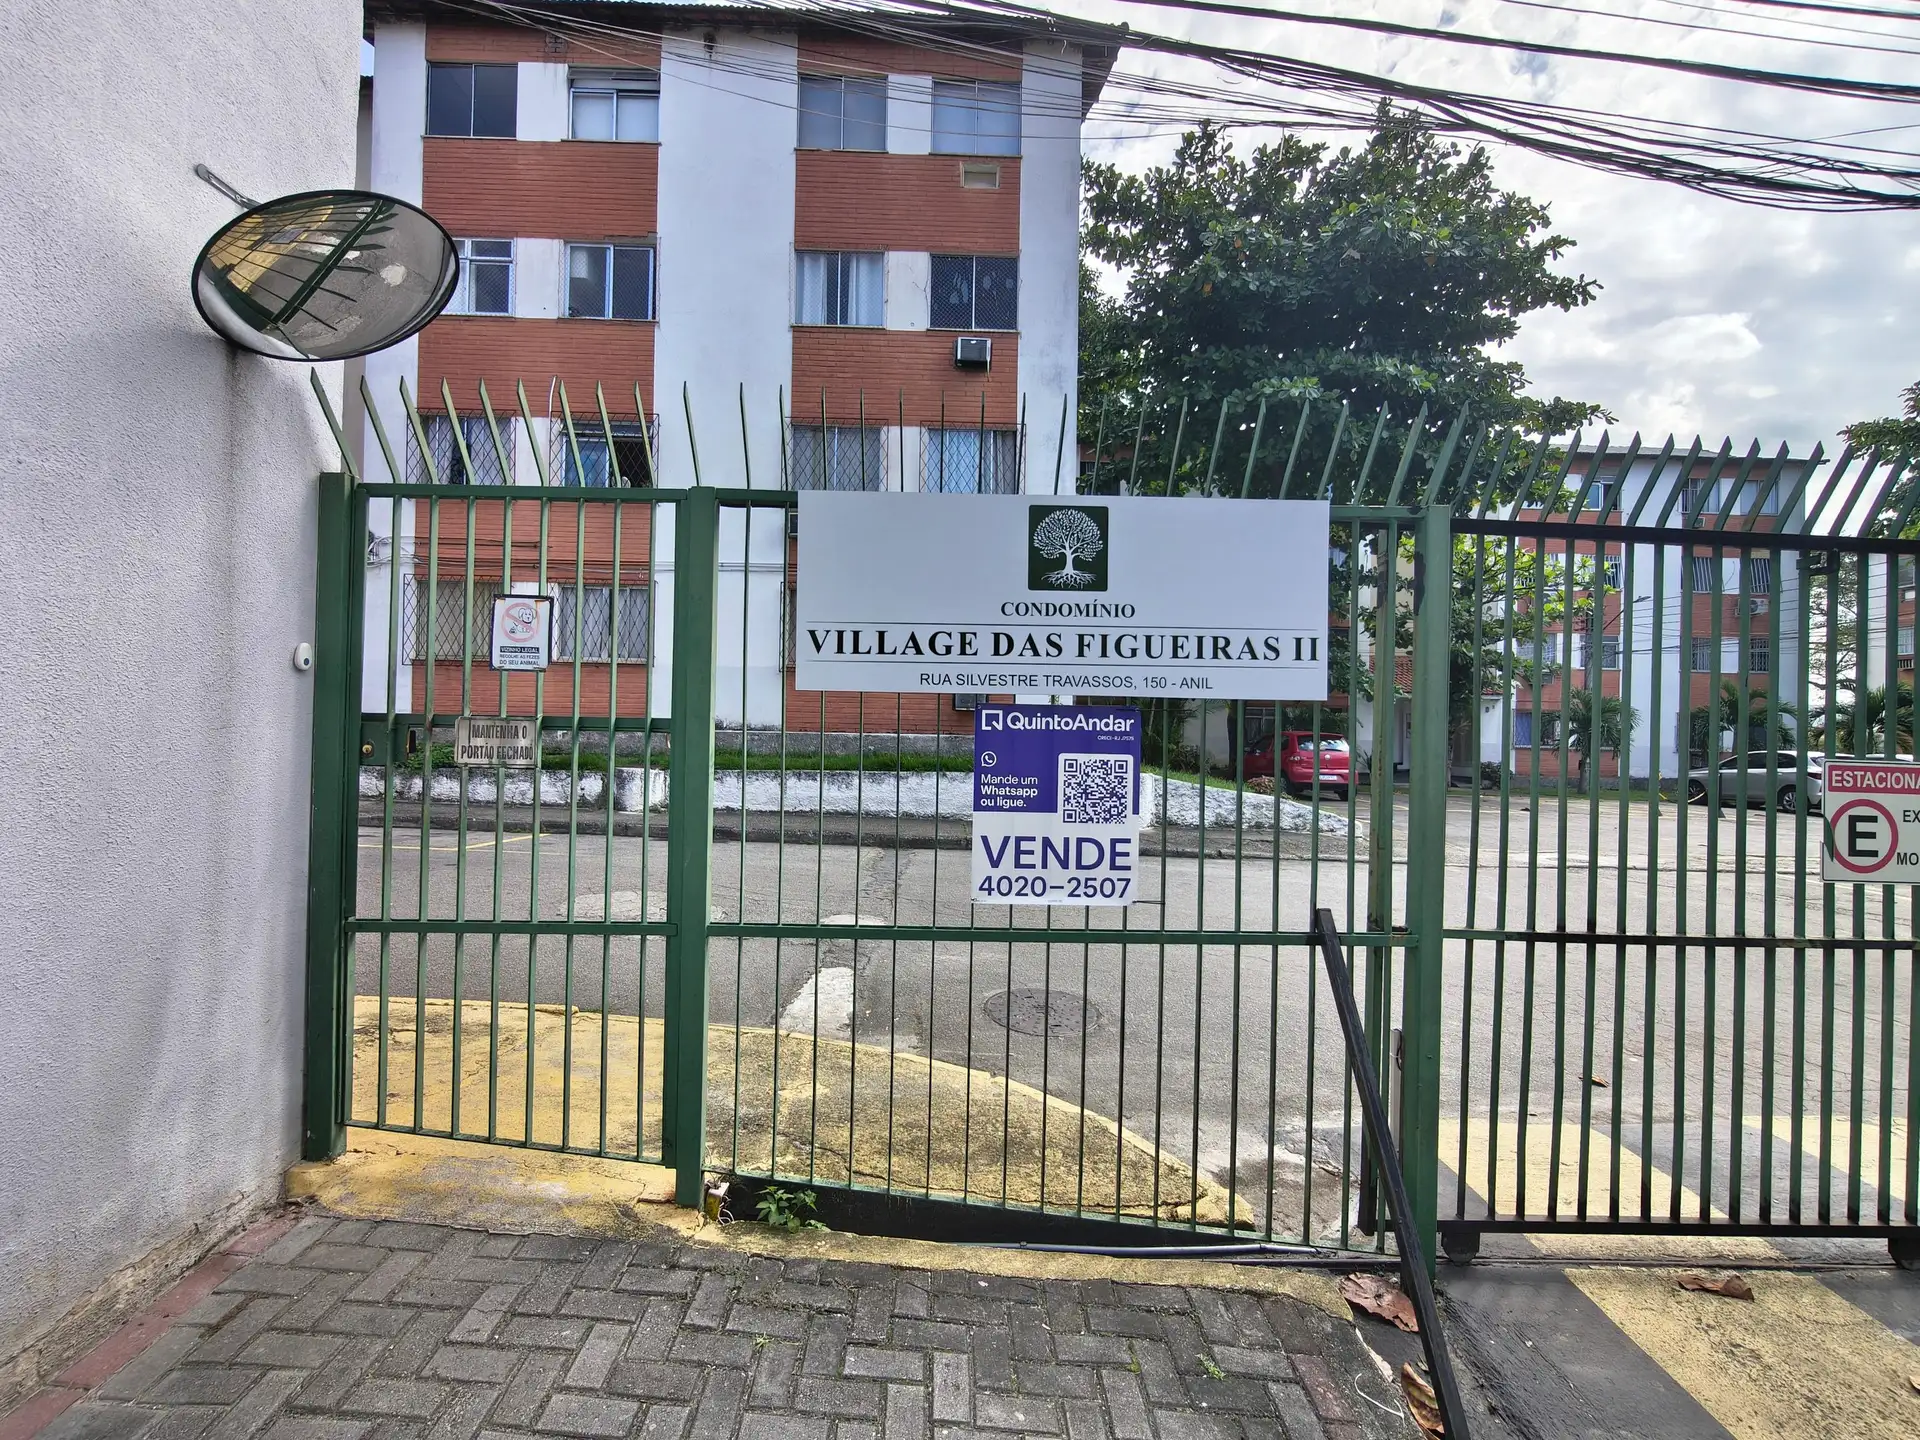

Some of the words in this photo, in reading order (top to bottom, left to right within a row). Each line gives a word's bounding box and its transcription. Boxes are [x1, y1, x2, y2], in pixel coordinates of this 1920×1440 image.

[1000, 599, 1135, 618] CONDOMÍNIO
[806, 629, 979, 656] VILLAGE
[990, 632, 1063, 657] DAS
[1074, 633, 1281, 661] FIGUEIRAS
[1292, 636, 1319, 662] II
[919, 673, 951, 686] RUA
[956, 674, 1039, 687] SILVESTRE
[1043, 675, 1138, 690] TRAVASSOS,
[1142, 677, 1167, 689] 150
[1179, 678, 1214, 690] ANIL
[1006, 712, 1135, 732] QuintoAndar
[472, 724, 519, 739] MANTENHA
[522, 725, 528, 739] O
[460, 742, 494, 760] PORTÃO
[497, 744, 534, 760] FECHADO
[980, 774, 1019, 785] Mande
[1021, 776, 1038, 785] um
[980, 785, 1038, 798] Whatsapp
[980, 798, 994, 807] ou
[996, 797, 1027, 809] ligue.
[1848, 814, 1879, 858] E
[980, 835, 1132, 871] VENDE
[1896, 852, 1919, 866] MO
[978, 875, 1132, 899] 4020-2507
